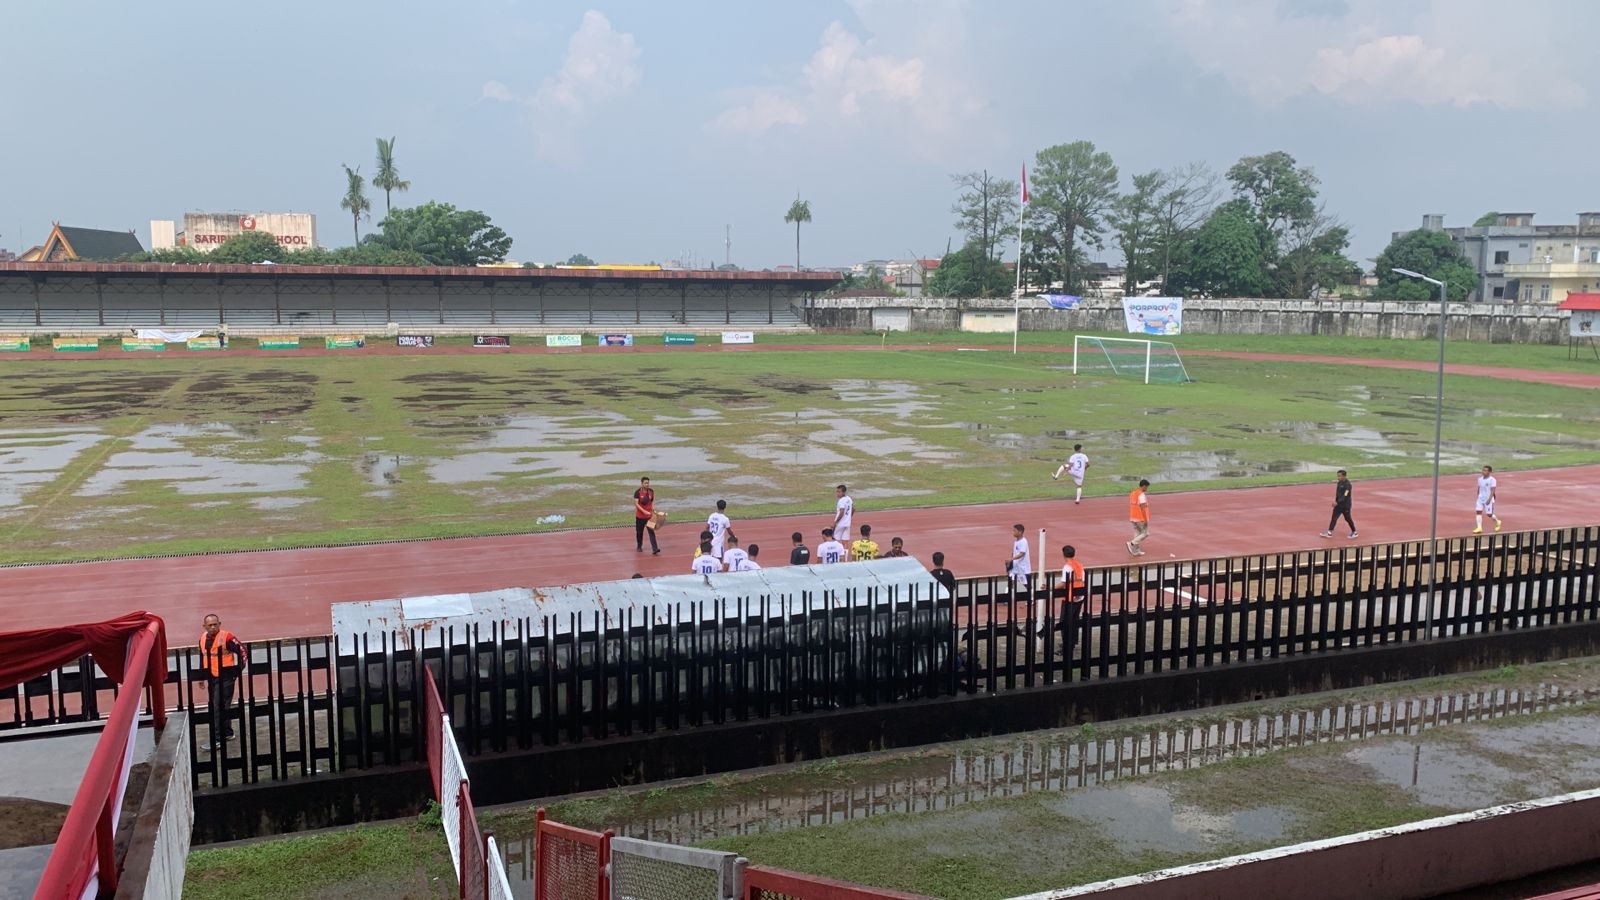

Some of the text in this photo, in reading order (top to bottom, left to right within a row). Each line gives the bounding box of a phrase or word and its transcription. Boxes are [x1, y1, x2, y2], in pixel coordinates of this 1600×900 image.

[274, 235, 308, 245] HOOL
[857, 550, 871, 560] 26
[702, 565, 712, 574] 10
